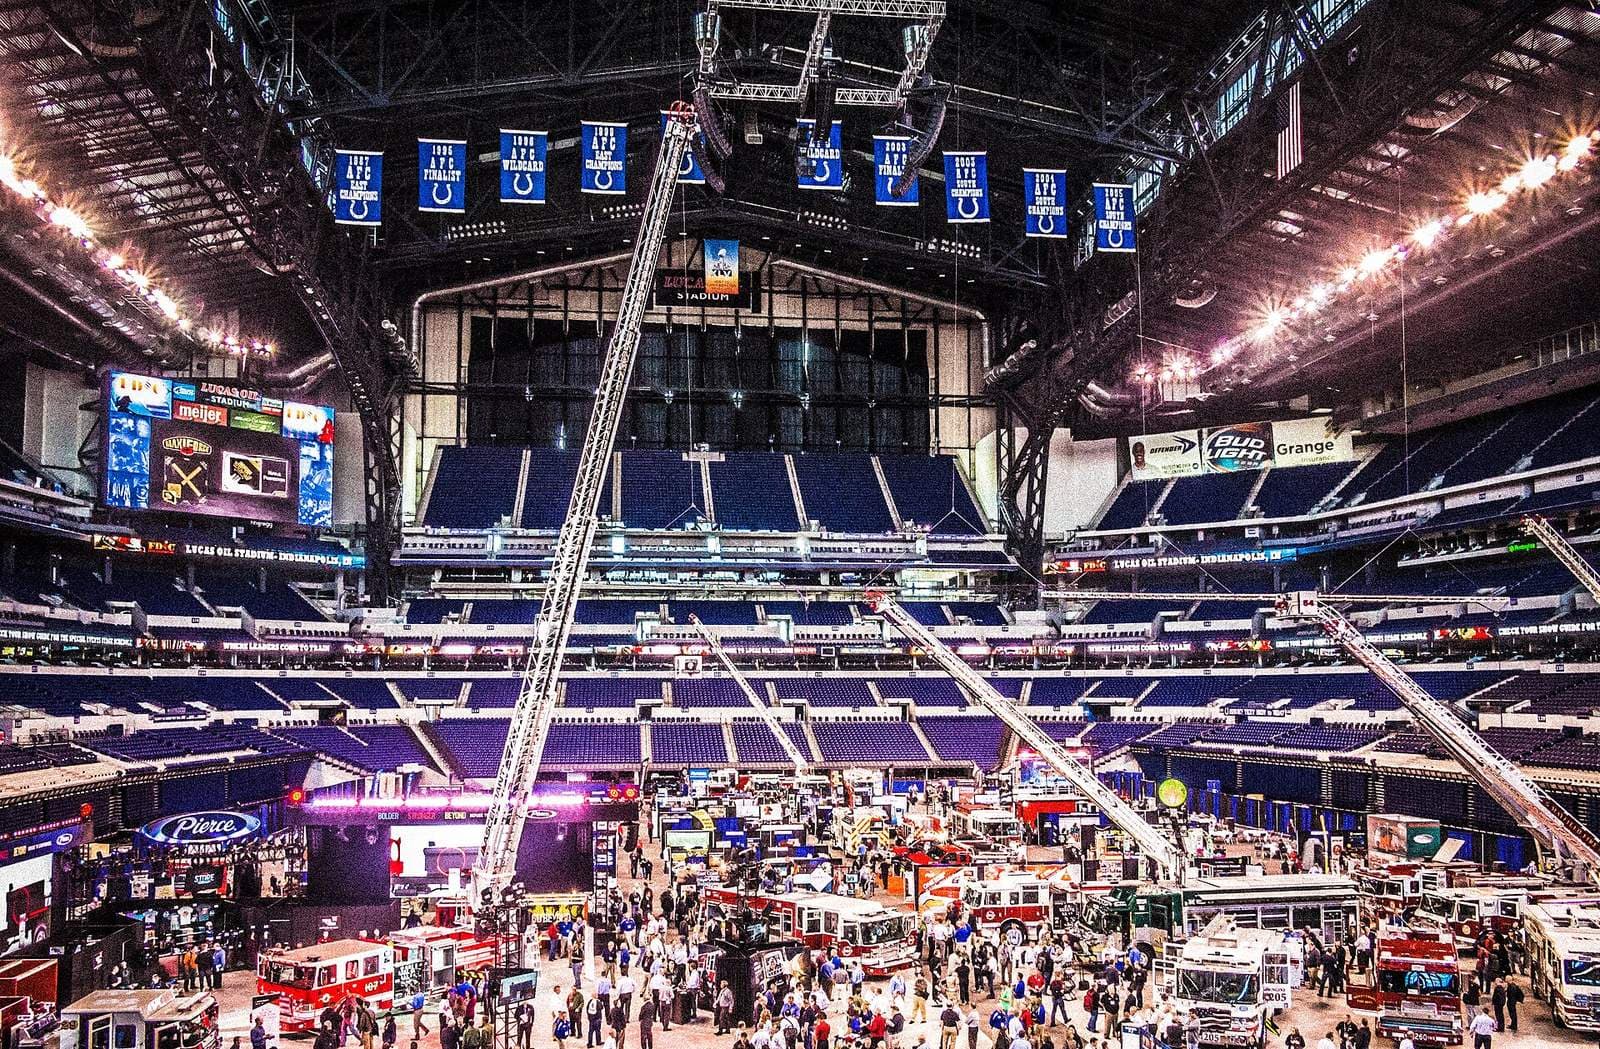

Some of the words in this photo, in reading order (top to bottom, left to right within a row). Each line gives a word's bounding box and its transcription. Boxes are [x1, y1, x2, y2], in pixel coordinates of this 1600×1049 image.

[885, 141, 906, 152] 2003
[595, 151, 613, 160] EAST
[502, 159, 544, 171] WILDCARD
[585, 159, 623, 170] CHAMPIONS
[423, 169, 461, 182] FINALIST
[350, 180, 368, 190] EAST
[340, 189, 378, 201] CHAMPIONS
[1028, 205, 1064, 216] CHAMPIONS
[1098, 220, 1132, 231] CHAMPIONS
[677, 292, 729, 301] STADIUM
[200, 382, 239, 399] LUCAS
[239, 389, 259, 401] OIL
[210, 395, 250, 409] STADIUM
[179, 404, 222, 425] meijer
[1215, 435, 1265, 448] BUD
[1150, 445, 1183, 455] DEFENDER
[1206, 447, 1267, 460] LIGHT
[1276, 441, 1334, 456] Grange
[185, 544, 215, 555] LUCAS
[216, 546, 233, 557] OIL
[1114, 559, 1140, 569] LUCAS
[1141, 558, 1156, 568] OIL
[1499, 627, 1520, 636] CHECK
[1520, 626, 1538, 635] YOUR
[1539, 624, 1559, 634] SHOW
[1559, 623, 1580, 633] GUIDE
[378, 812, 399, 820] BOLDER
[445, 811, 466, 820] BEYOND
[173, 816, 230, 838] Pierce
[1204, 1031, 1220, 1042] 205
